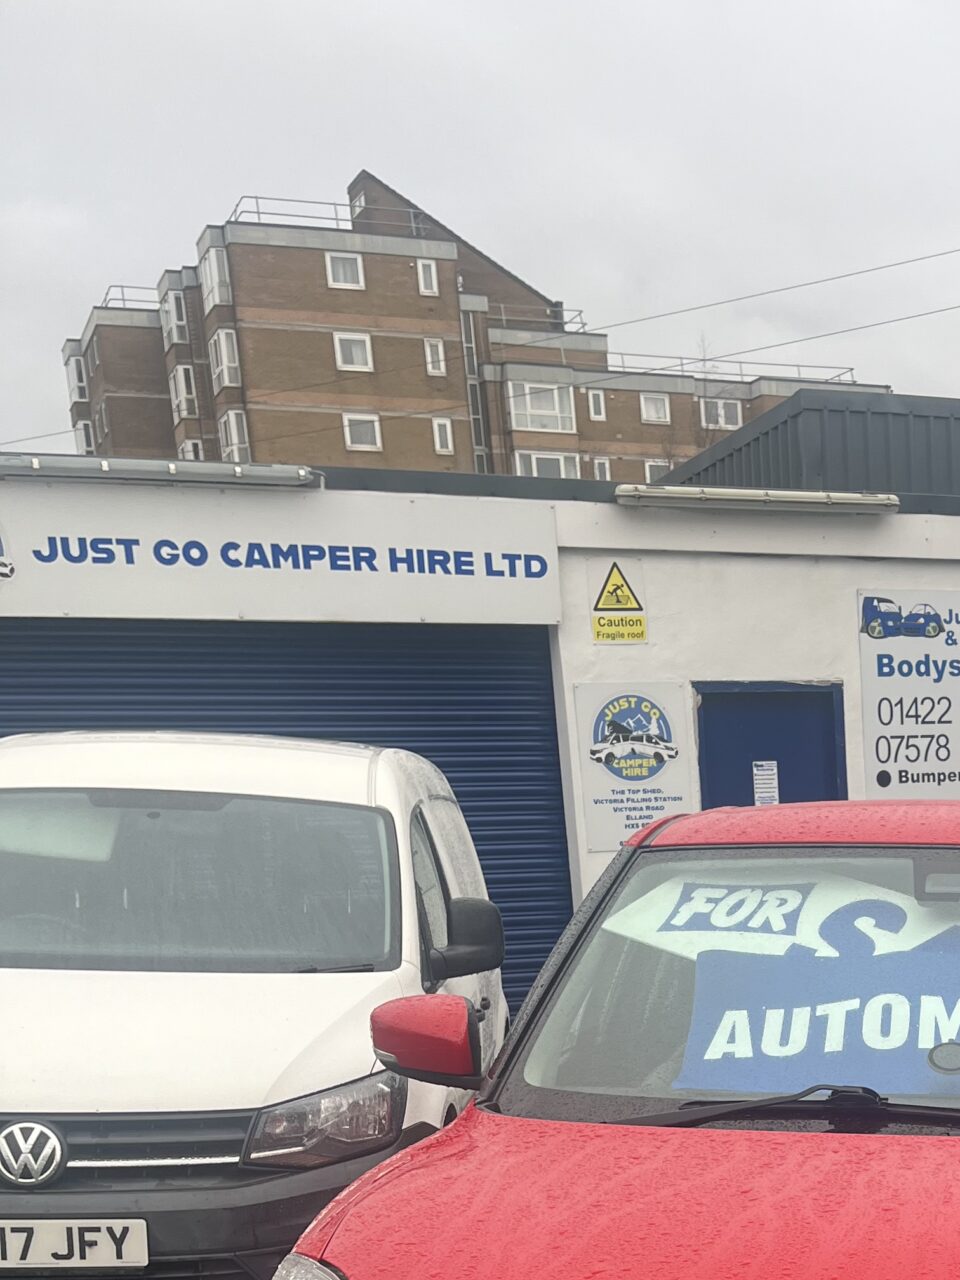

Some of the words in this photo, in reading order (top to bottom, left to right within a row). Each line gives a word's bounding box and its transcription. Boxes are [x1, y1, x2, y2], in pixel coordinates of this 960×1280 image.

[32, 536, 140, 565] JUST
[153, 539, 209, 567] GO
[220, 541, 379, 572] CAMPER
[388, 547, 475, 576] HIRE
[484, 552, 548, 579] LTD
[597, 616, 643, 628] Caution
[596, 630, 625, 641] Fragile
[627, 630, 644, 639] roof
[944, 630, 958, 647] &
[604, 697, 638, 721] JUST
[641, 701, 661, 721] GO
[877, 696, 953, 726] 01422
[875, 733, 951, 764] 07578
[612, 758, 657, 768] CAMPER
[622, 767, 649, 777] HIRE
[670, 888, 803, 932] FOR
[50, 1226, 130, 1260] JFY
